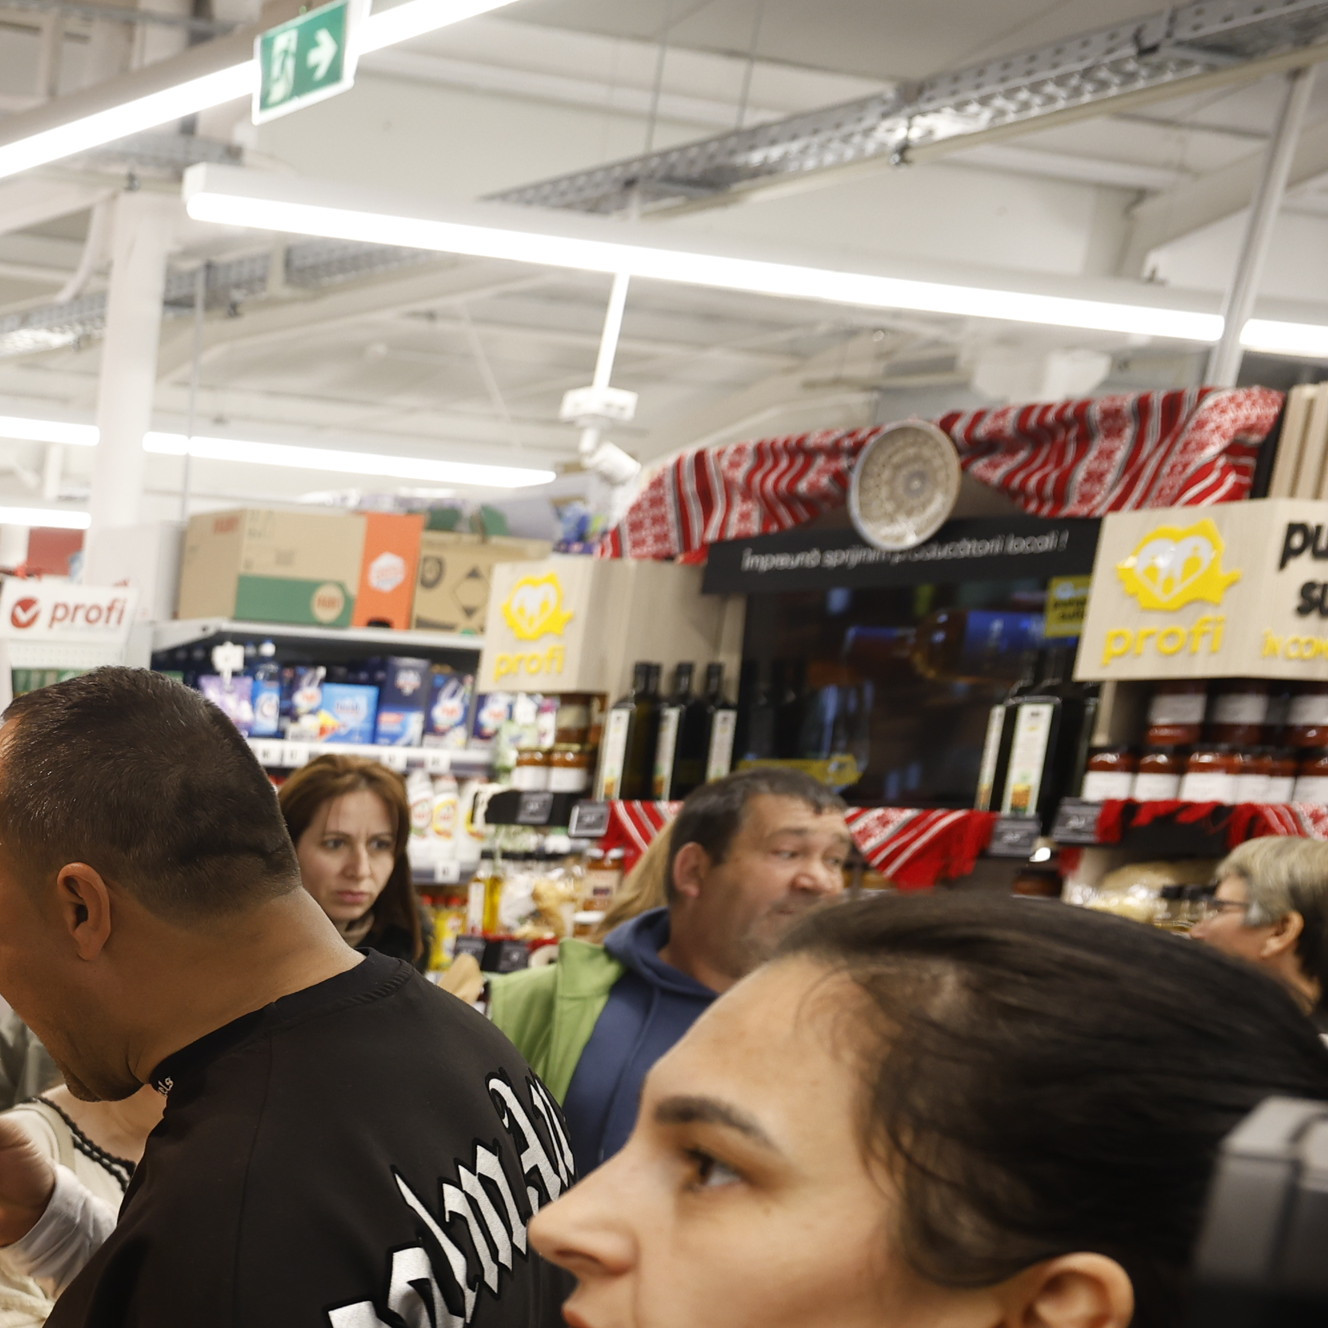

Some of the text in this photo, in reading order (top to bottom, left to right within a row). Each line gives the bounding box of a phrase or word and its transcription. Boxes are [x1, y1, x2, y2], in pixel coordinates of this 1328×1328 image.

[48, 596, 127, 631] profi
[1100, 615, 1226, 666] profi
[493, 644, 566, 684] profi
